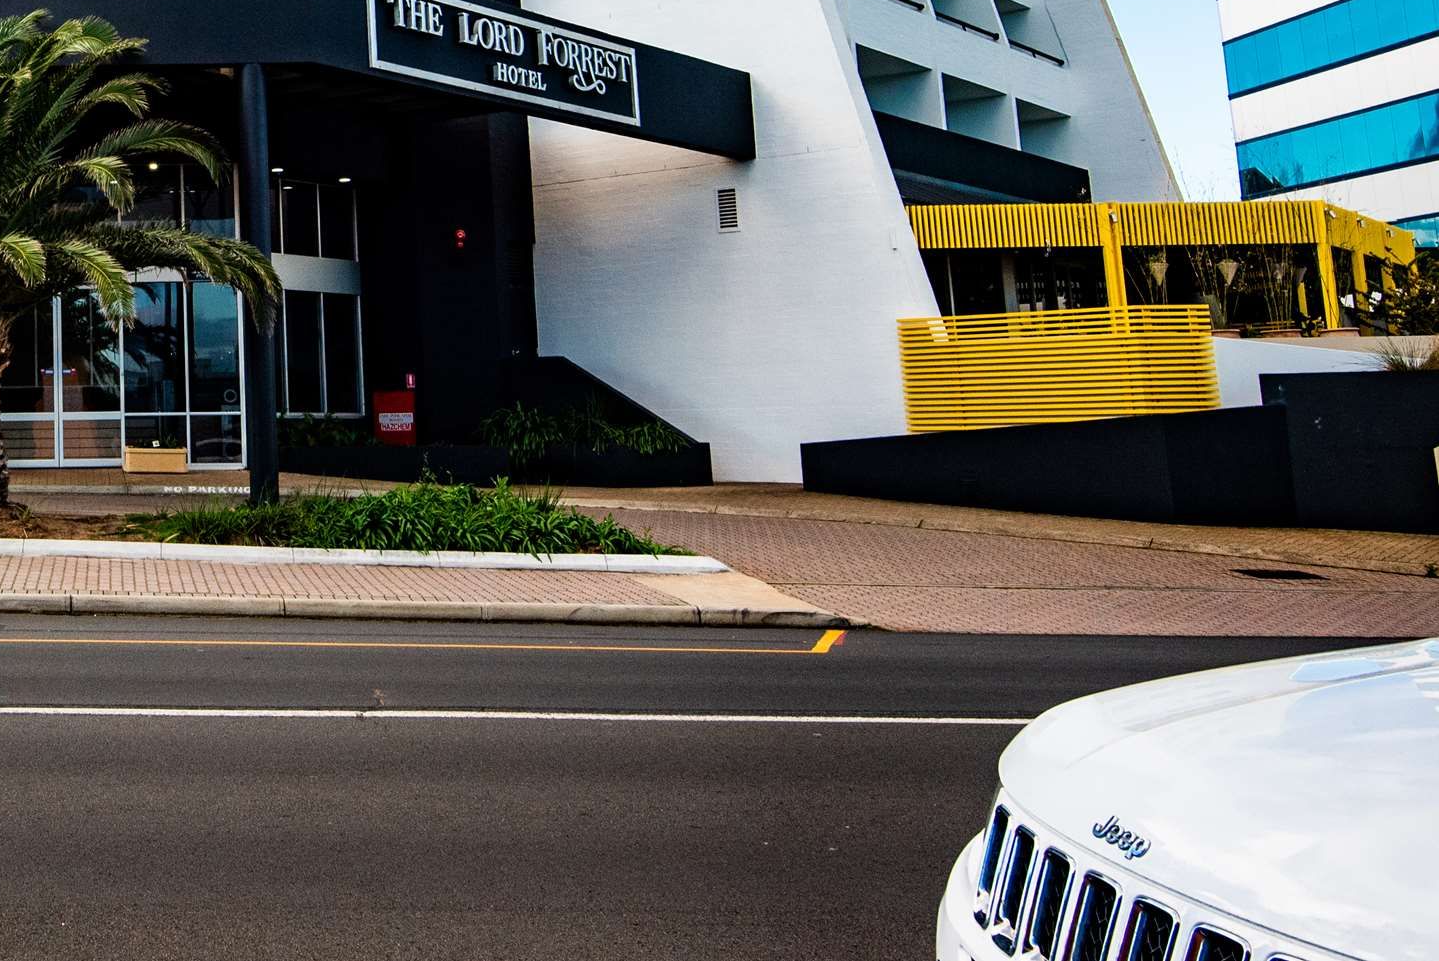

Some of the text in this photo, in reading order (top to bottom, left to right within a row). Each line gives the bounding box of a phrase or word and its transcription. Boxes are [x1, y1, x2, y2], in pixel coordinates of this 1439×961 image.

[458, 12, 525, 57] LORD
[537, 28, 631, 96] FORREST
[493, 62, 547, 91] HOTEL
[163, 486, 251, 494] NO PARKING
[1092, 815, 1152, 861] Jeep
